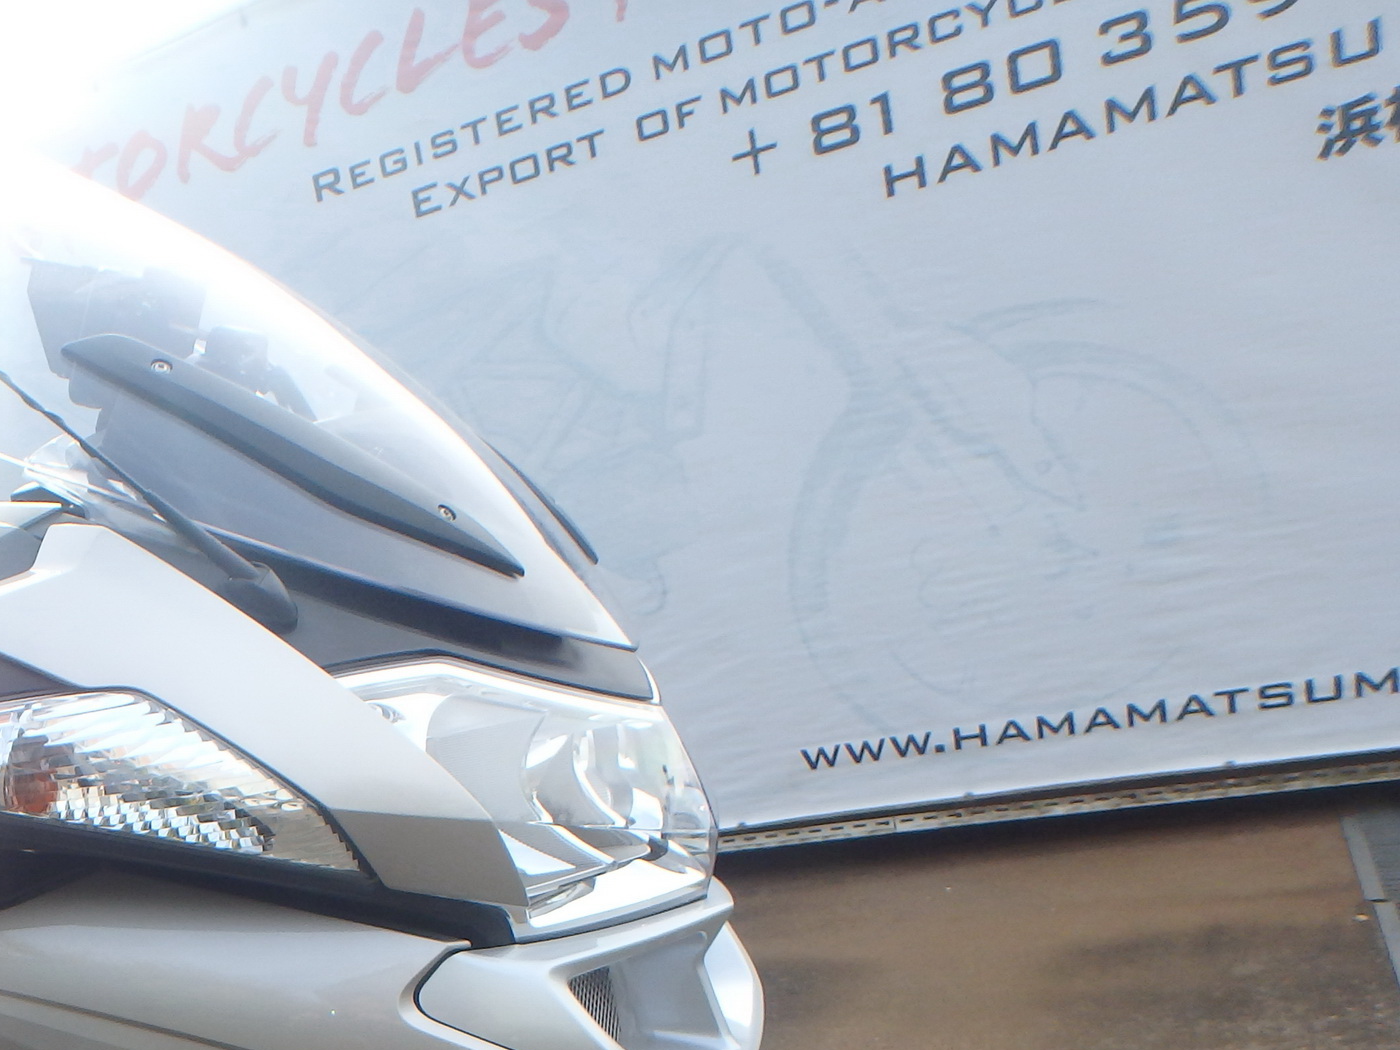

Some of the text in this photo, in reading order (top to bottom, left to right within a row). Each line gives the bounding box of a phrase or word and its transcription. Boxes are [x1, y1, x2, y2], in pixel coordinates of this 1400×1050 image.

[311, 67, 632, 203] REGISTERED
[411, 129, 605, 218] EXPORT
[635, 95, 702, 142] OF
[811, 90, 894, 156] 81
[941, 38, 1063, 115] 80
[883, 16, 1382, 199] HAMAMATSU
[1315, 84, 1400, 161] 浜
